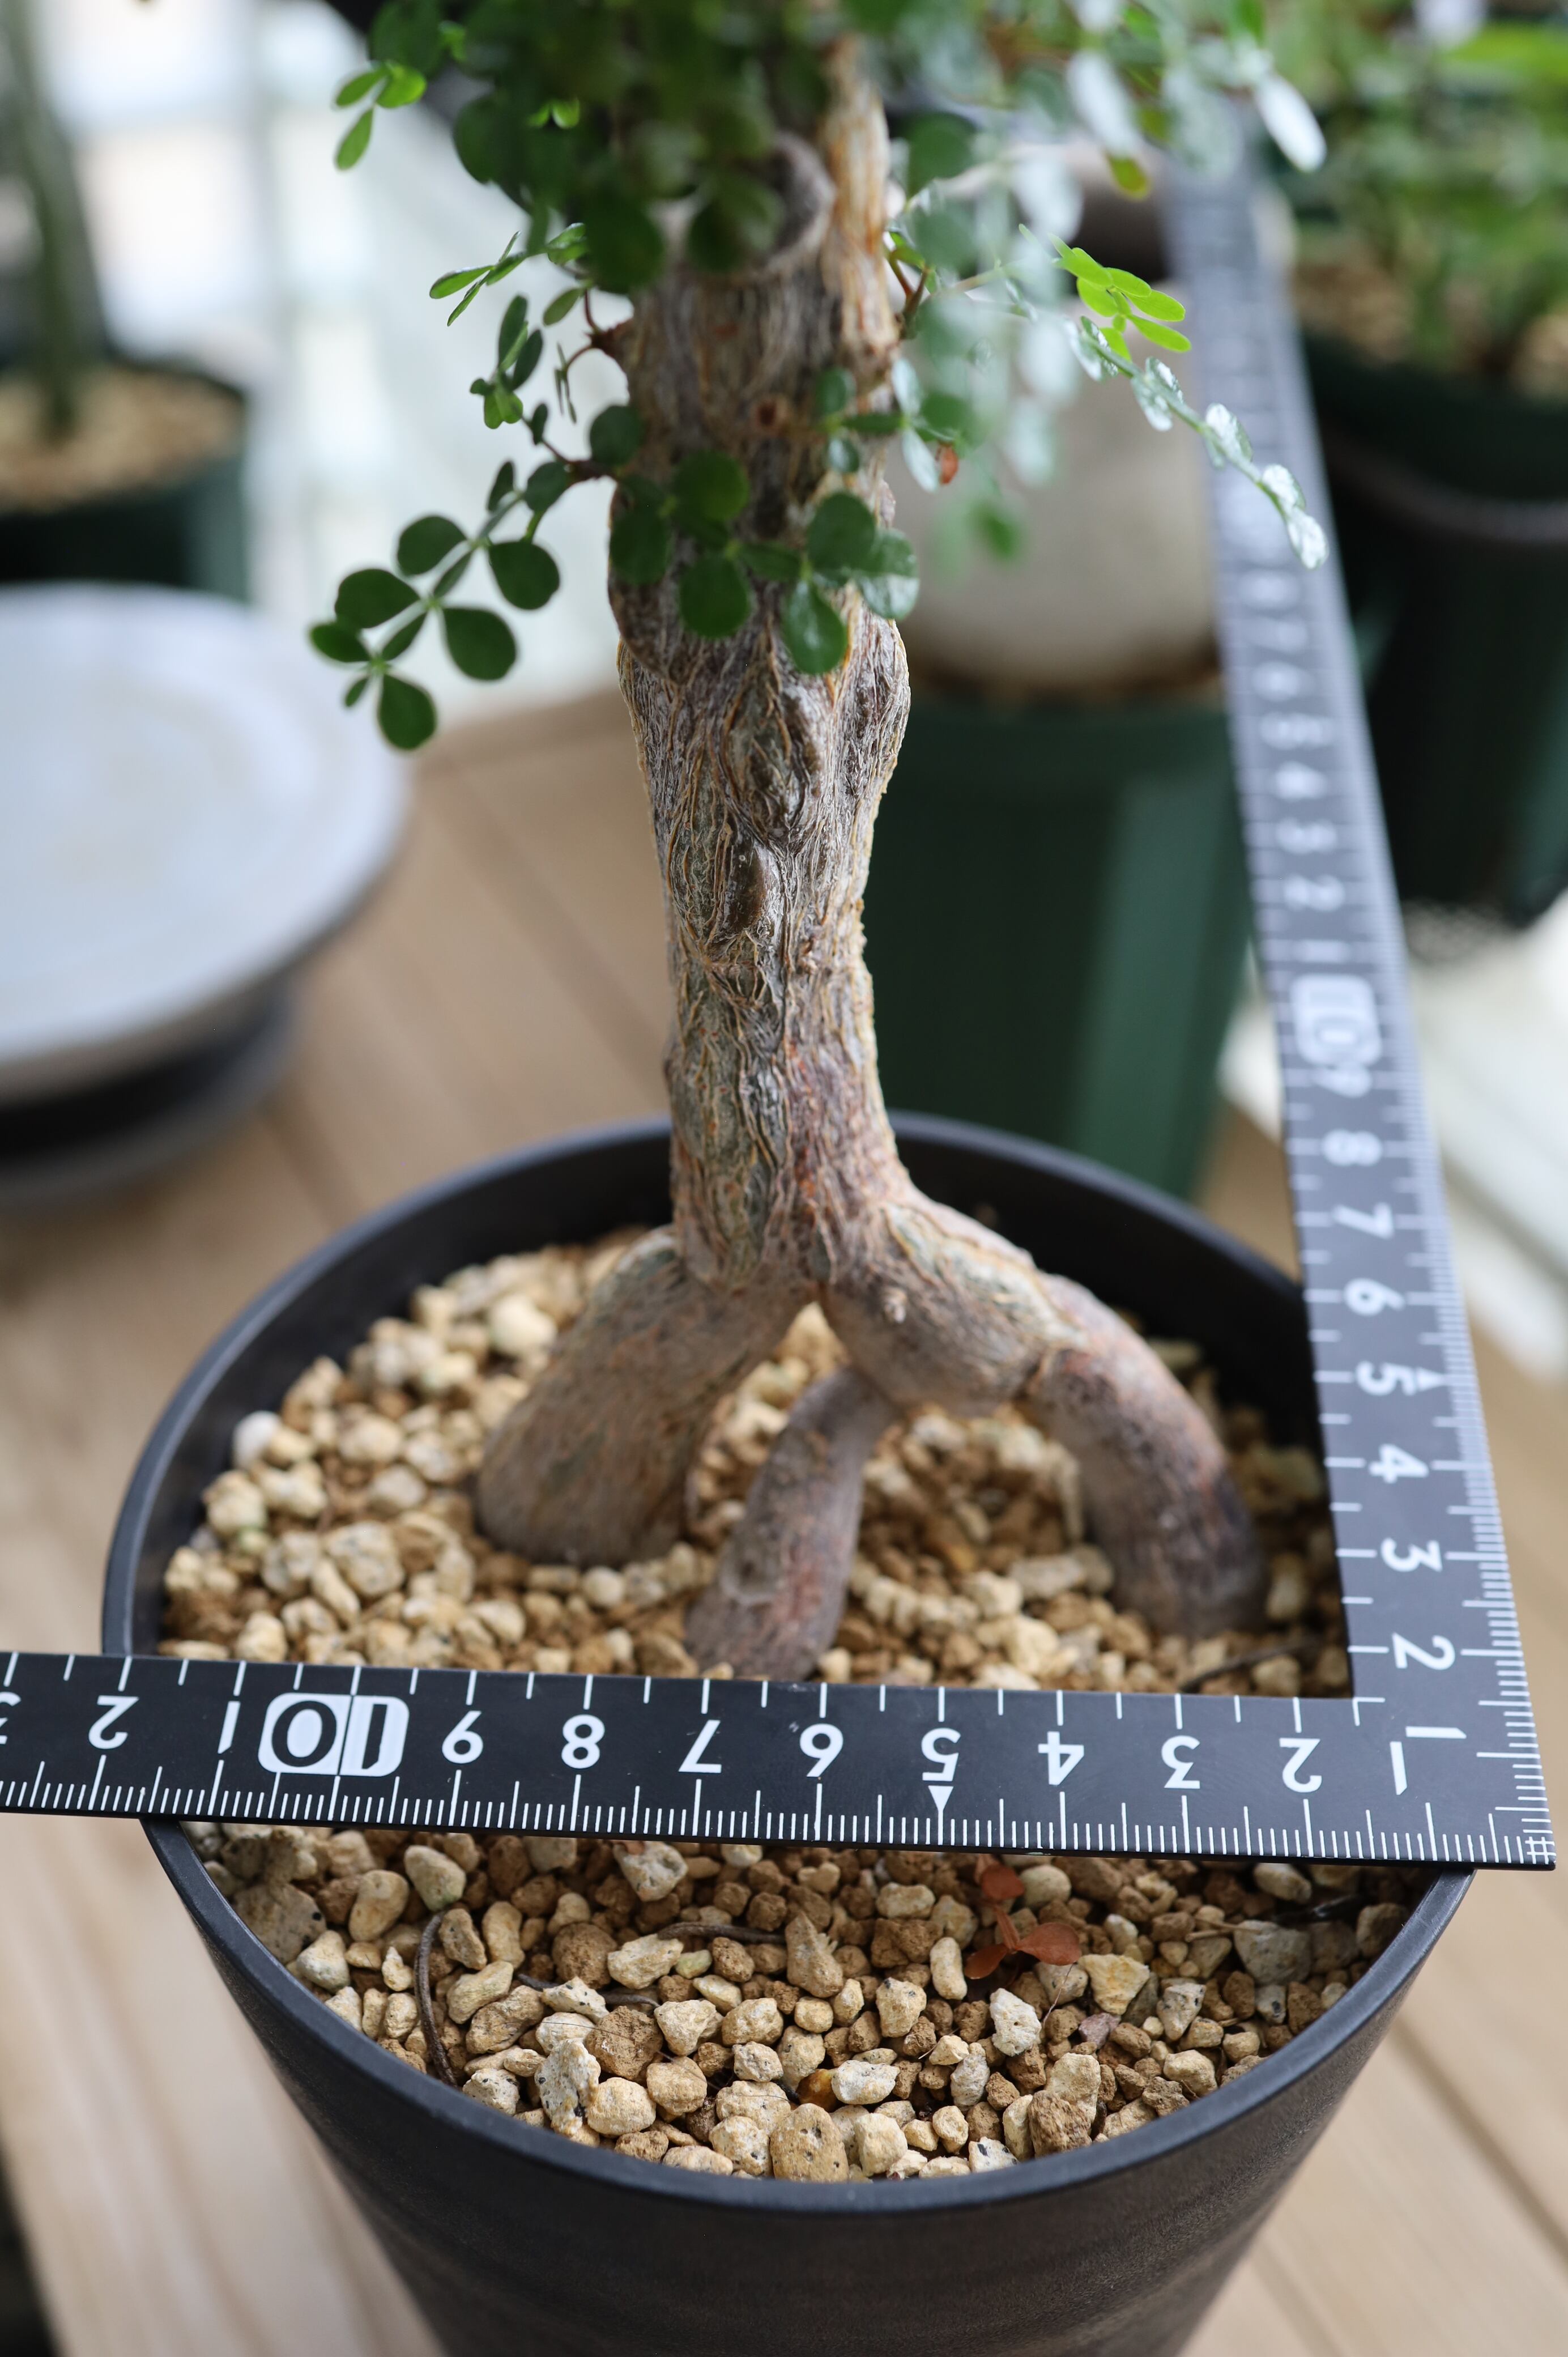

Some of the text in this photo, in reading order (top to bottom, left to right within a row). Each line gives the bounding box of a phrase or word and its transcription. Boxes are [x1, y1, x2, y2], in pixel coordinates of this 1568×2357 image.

[1320, 1130, 1383, 1166] 8
[1331, 1203, 1395, 1239] 7
[1344, 1278, 1405, 1316] 6
[1356, 1361, 1418, 1396] 5
[1369, 1444, 1429, 1483] 4
[1380, 1538, 1443, 1572] 3
[1392, 1633, 1455, 1670] 2
[89, 1696, 138, 1748] 2
[218, 1701, 240, 1754] 1
[271, 1700, 389, 1770] 10
[442, 1711, 483, 1763] 9
[561, 1714, 605, 1769] 8
[679, 1720, 722, 1773] 7
[1405, 1726, 1467, 1739] 1
[799, 1724, 843, 1777] 6
[922, 1728, 961, 1782] 5
[1038, 1731, 1084, 1785] 4
[1161, 1735, 1200, 1789] 3
[1279, 1738, 1322, 1793] 2
[1390, 1741, 1407, 1796] 1
